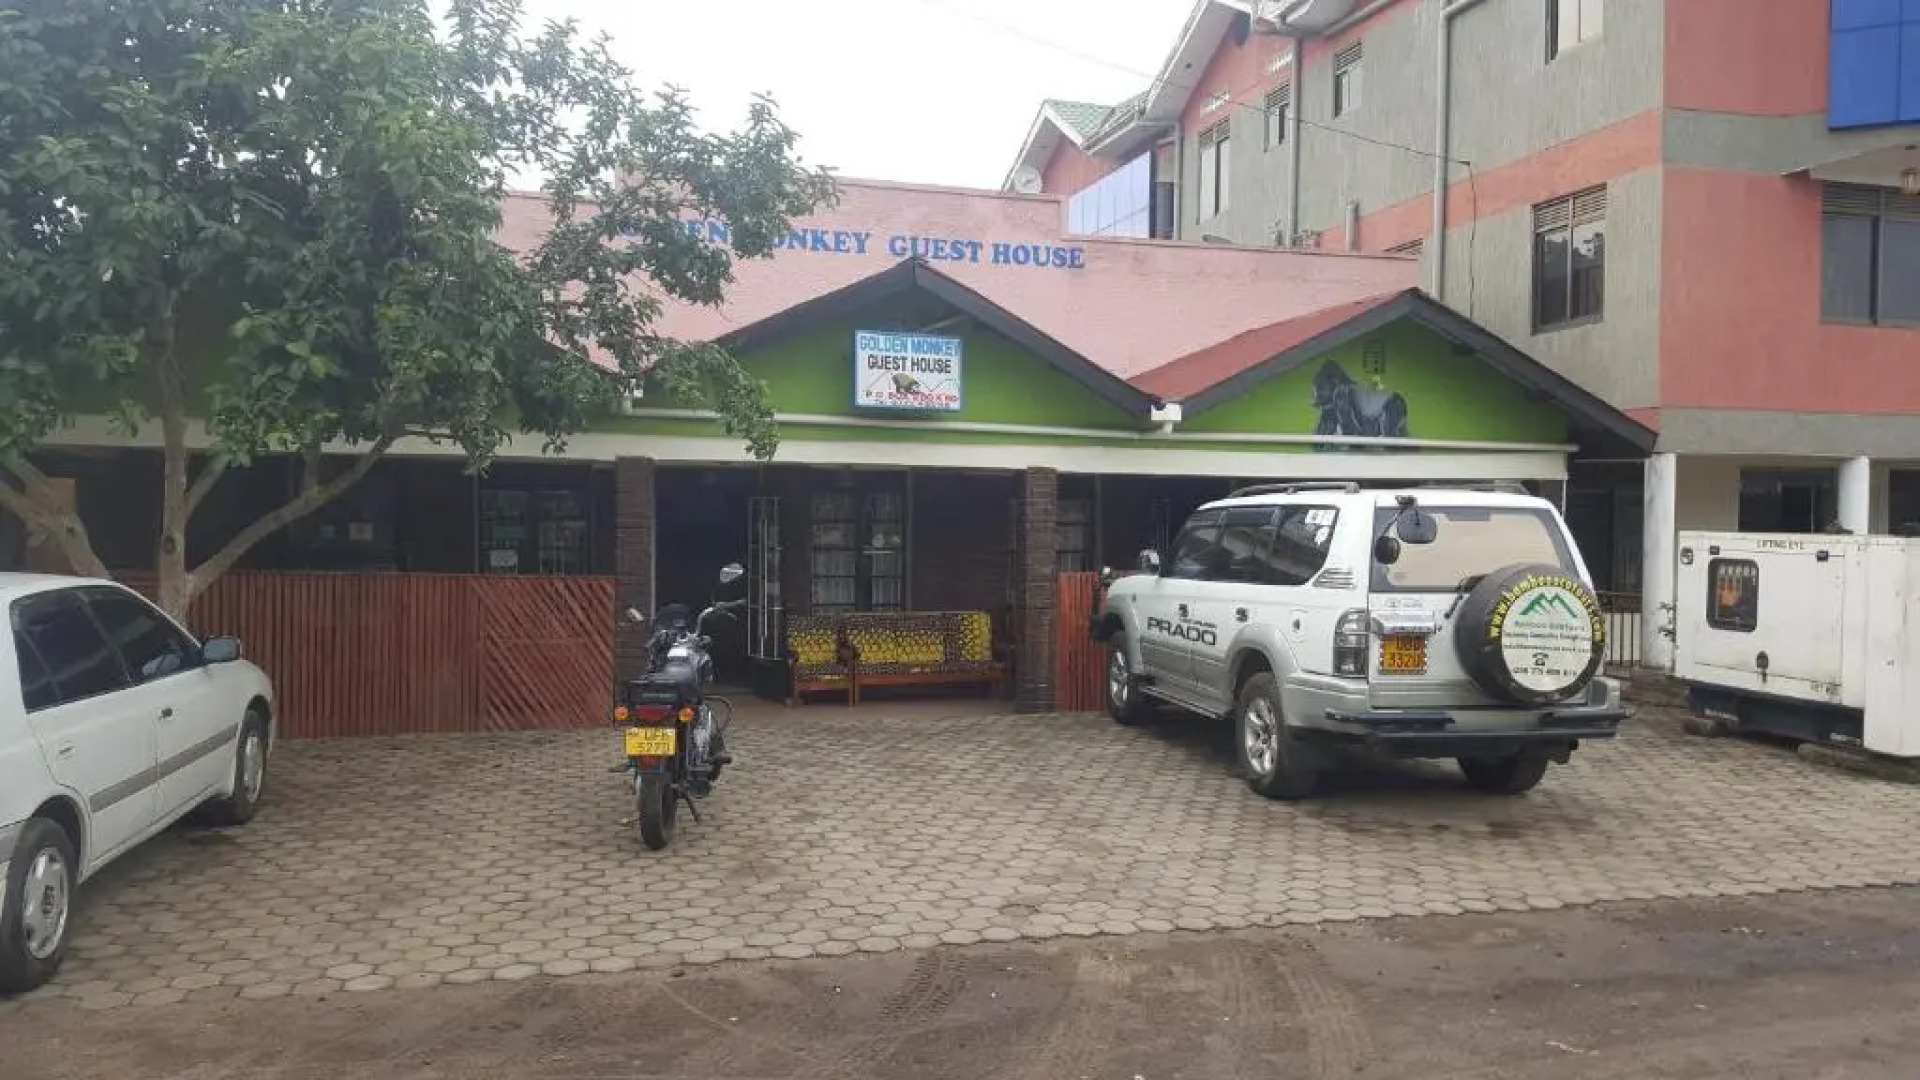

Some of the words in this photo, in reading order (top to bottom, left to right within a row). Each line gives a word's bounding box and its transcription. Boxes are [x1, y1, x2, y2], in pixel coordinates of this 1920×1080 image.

[888, 235, 983, 262] GUEST
[991, 242, 1086, 269] HOUSE
[860, 335, 907, 353] GOLDEN
[867, 354, 908, 372] GUEST
[911, 357, 952, 374] HOUSE
[1147, 616, 1216, 646] PRADO
